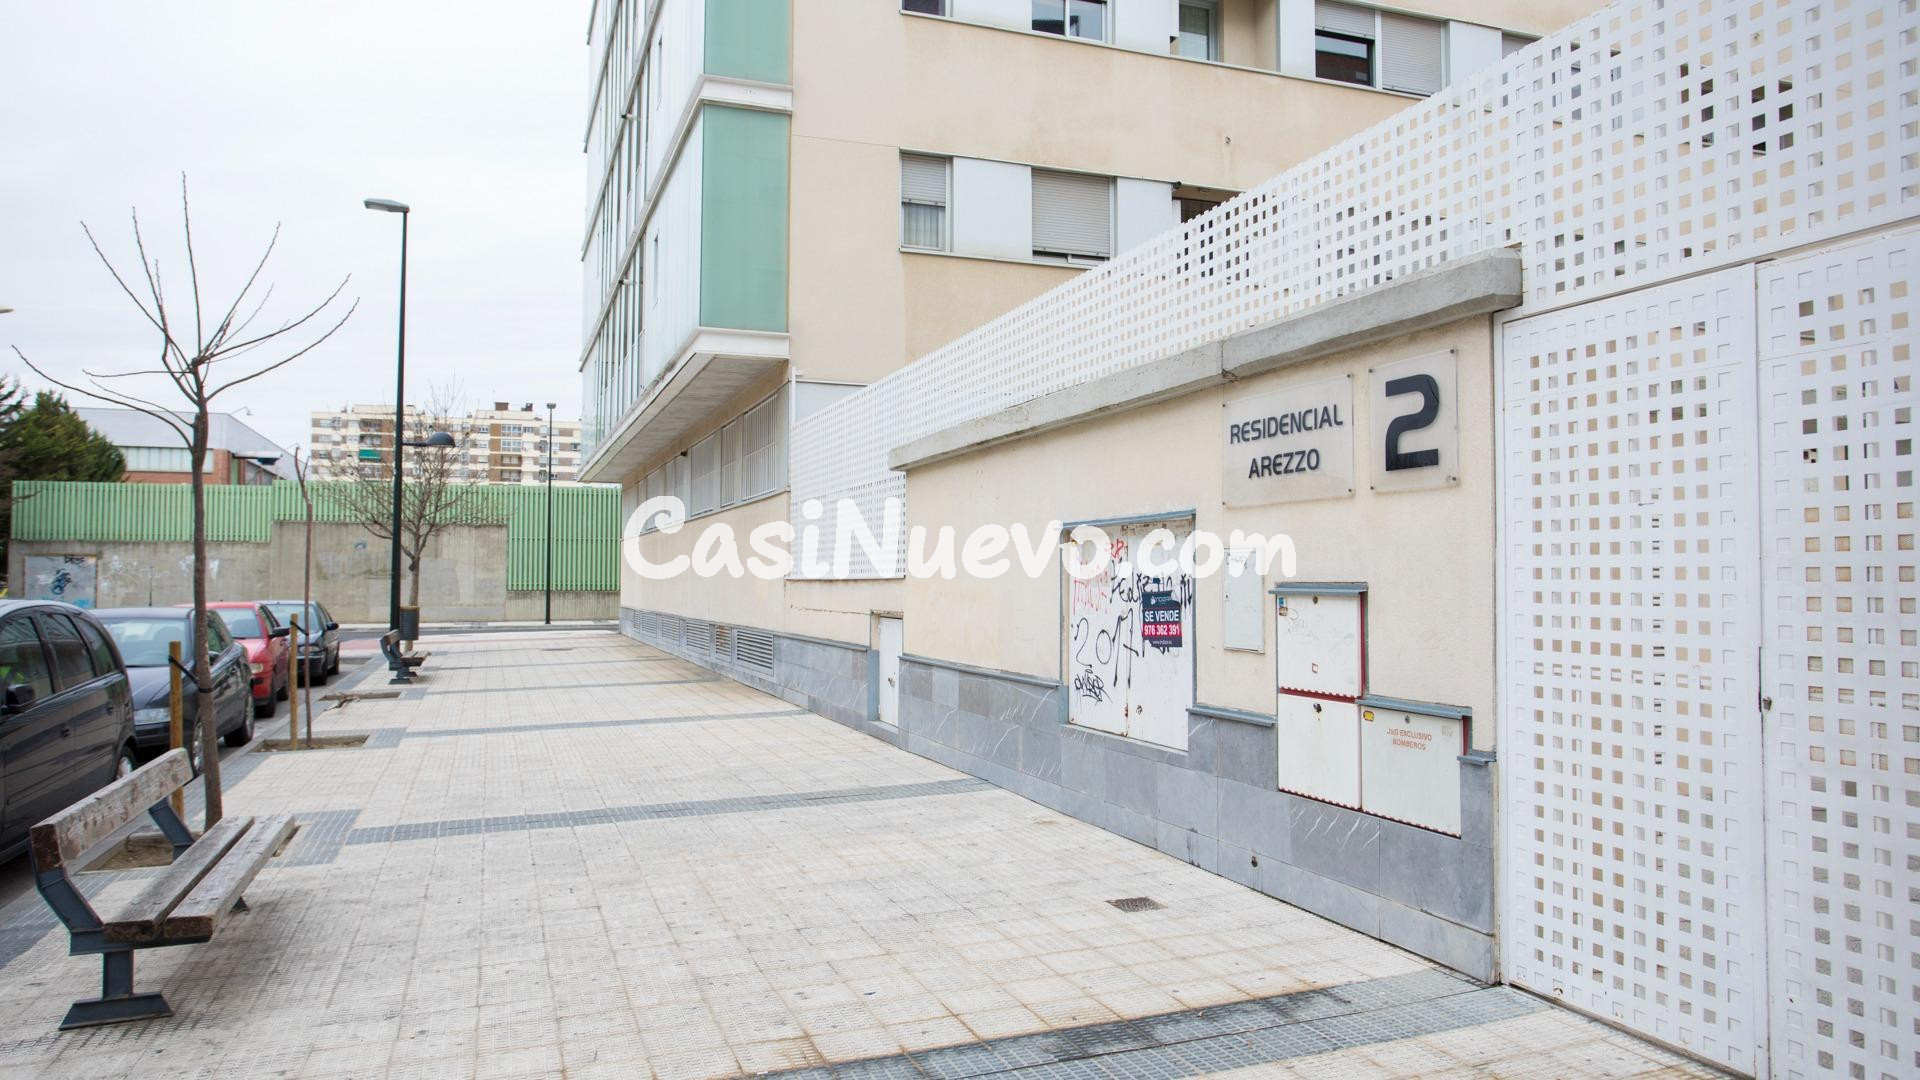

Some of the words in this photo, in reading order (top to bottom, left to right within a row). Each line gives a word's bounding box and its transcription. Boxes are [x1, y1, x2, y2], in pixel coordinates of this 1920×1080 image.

[1230, 404, 1344, 444] RESIDENCIAL
[1385, 374, 1440, 472] 2
[1248, 448, 1321, 479] AREZZO
[1144, 610, 1154, 622] SE
[1155, 609, 1180, 622] VENDE
[1144, 624, 1156, 636] 976
[1156, 624, 1168, 636] 362
[1168, 624, 1180, 636] 391
[1399, 729, 1433, 742] EXCLUSIVO
[1392, 737, 1427, 751] BOMBEROS
